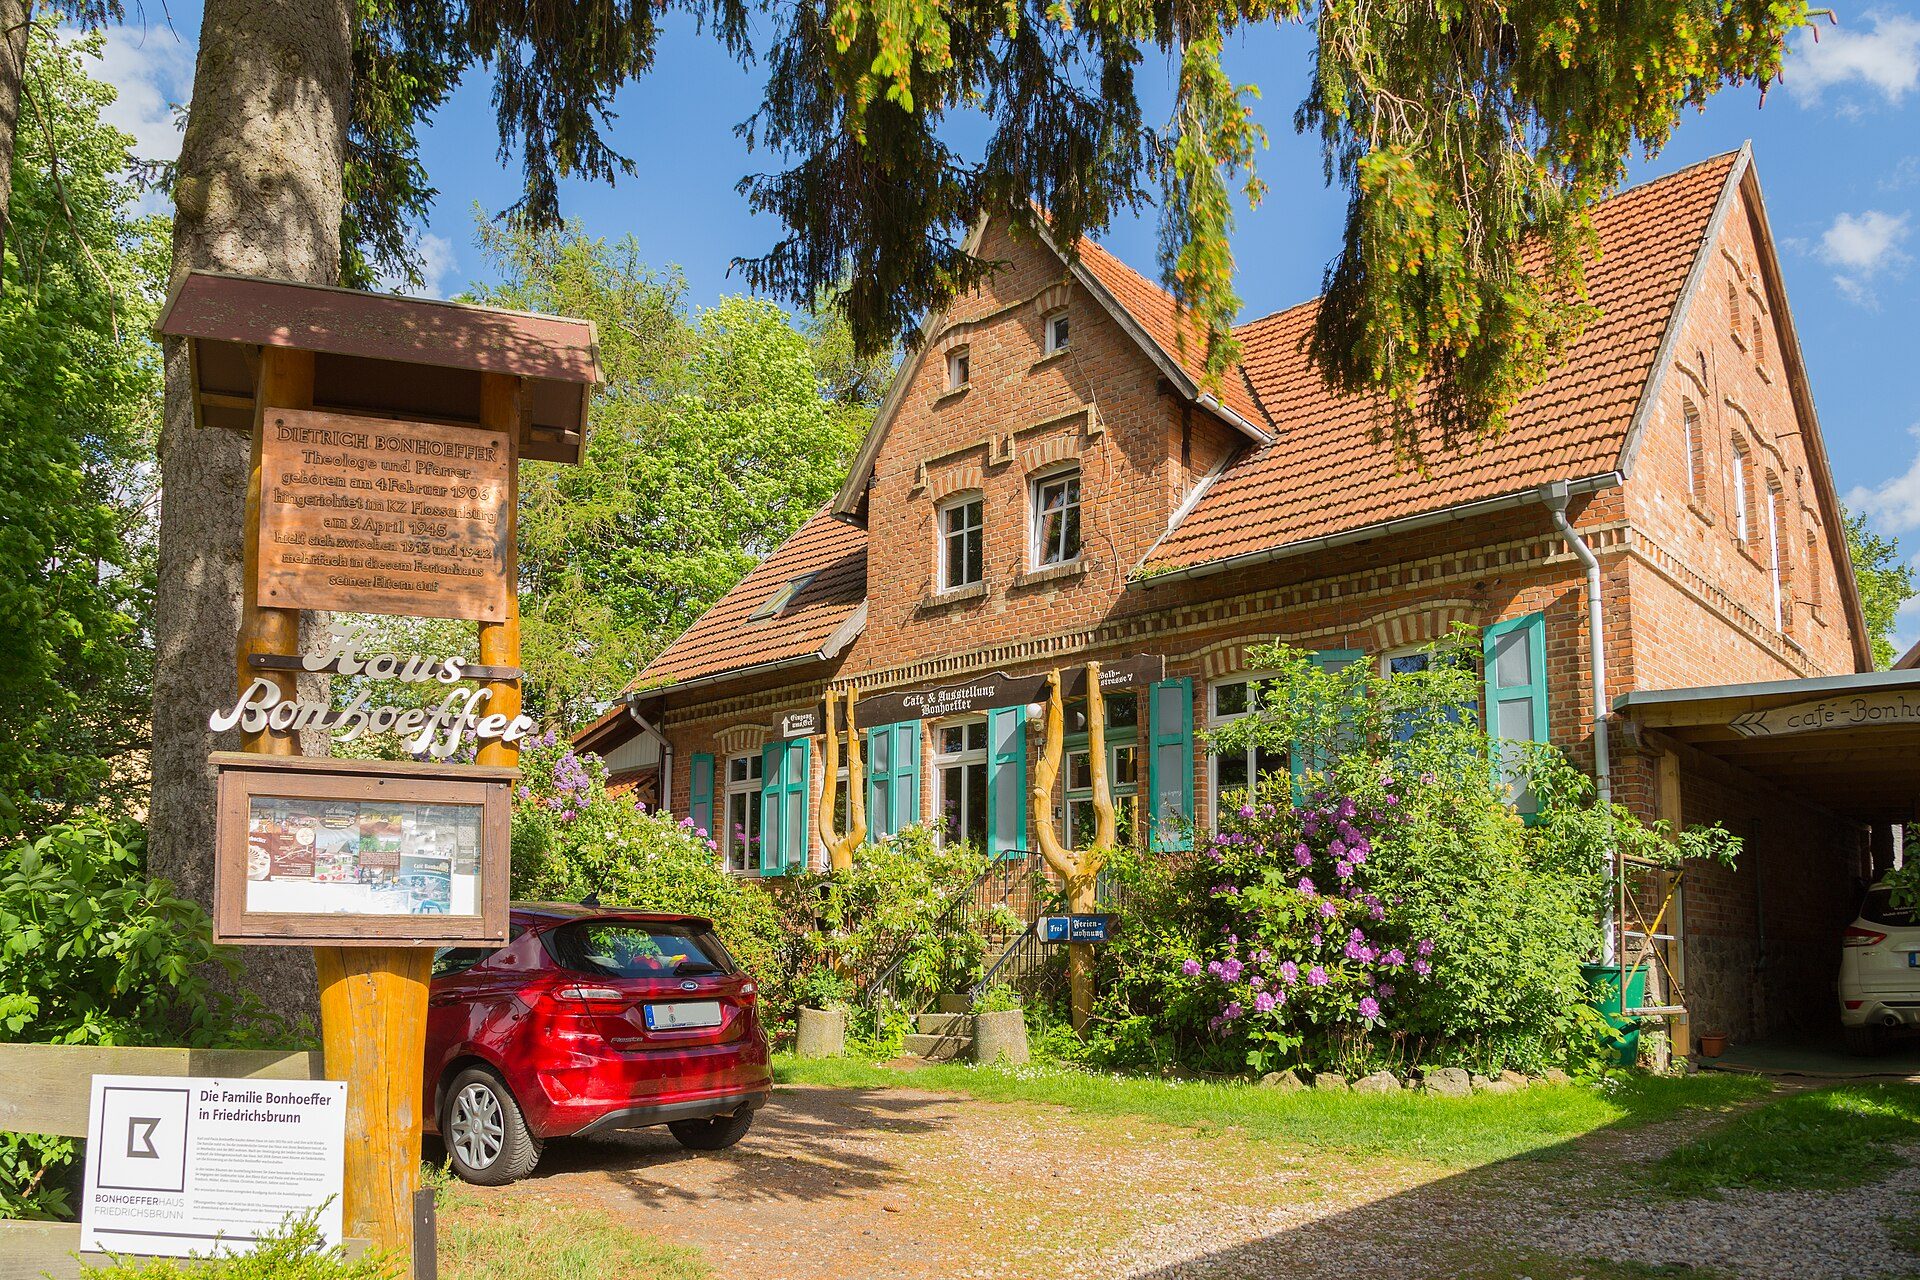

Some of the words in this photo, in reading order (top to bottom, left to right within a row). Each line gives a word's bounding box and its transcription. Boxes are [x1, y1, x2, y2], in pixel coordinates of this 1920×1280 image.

[277, 426, 369, 449] DIETRICH
[375, 436, 496, 462] BONHOEFFER
[302, 449, 377, 471] Theologe
[381, 460, 410, 473] und
[416, 460, 471, 479] Pfarrer
[282, 470, 346, 486] geboren
[350, 478, 372, 489] am
[388, 478, 448, 498] Februar
[451, 485, 490, 500] 1906
[274, 488, 363, 508] hingerichtet
[365, 499, 384, 511] im
[387, 500, 407, 513] KZ
[411, 501, 498, 524] Flossenbürg
[324, 517, 347, 529] am
[362, 517, 405, 536] April
[409, 521, 447, 537] 1945
[308, 534, 335, 547] sich
[337, 537, 398, 551] zwischen
[401, 541, 431, 554] 1913
[432, 544, 457, 556] und
[460, 547, 492, 559] 1942
[282, 553, 348, 567] mehrfach
[349, 557, 363, 568] in
[365, 557, 412, 571] diesem
[414, 560, 484, 577] Ferienhaus
[329, 575, 371, 588] seiner
[373, 576, 414, 591] Eltern
[416, 580, 439, 592] auf
[302, 624, 466, 684] Haus
[927, 692, 936, 703] &
[938, 685, 995, 702] Ausstellung
[209, 677, 534, 757] Bonhoeffer
[921, 699, 972, 716] Bonhoeffer
[1050, 924, 1063, 932] Frei
[1073, 919, 1102, 929] Ferien-
[1073, 929, 1104, 938] wohnung
[200, 1090, 219, 1102] Die
[222, 1091, 263, 1104] Familie
[266, 1092, 332, 1106] Bonhoeffer
[199, 1108, 210, 1120] in
[213, 1108, 301, 1123] Friedrichsbrunn
[95, 1194, 185, 1208] BONHOEFFERHAUS
[94, 1206, 184, 1220] FRIEDRICHSBRUNN
